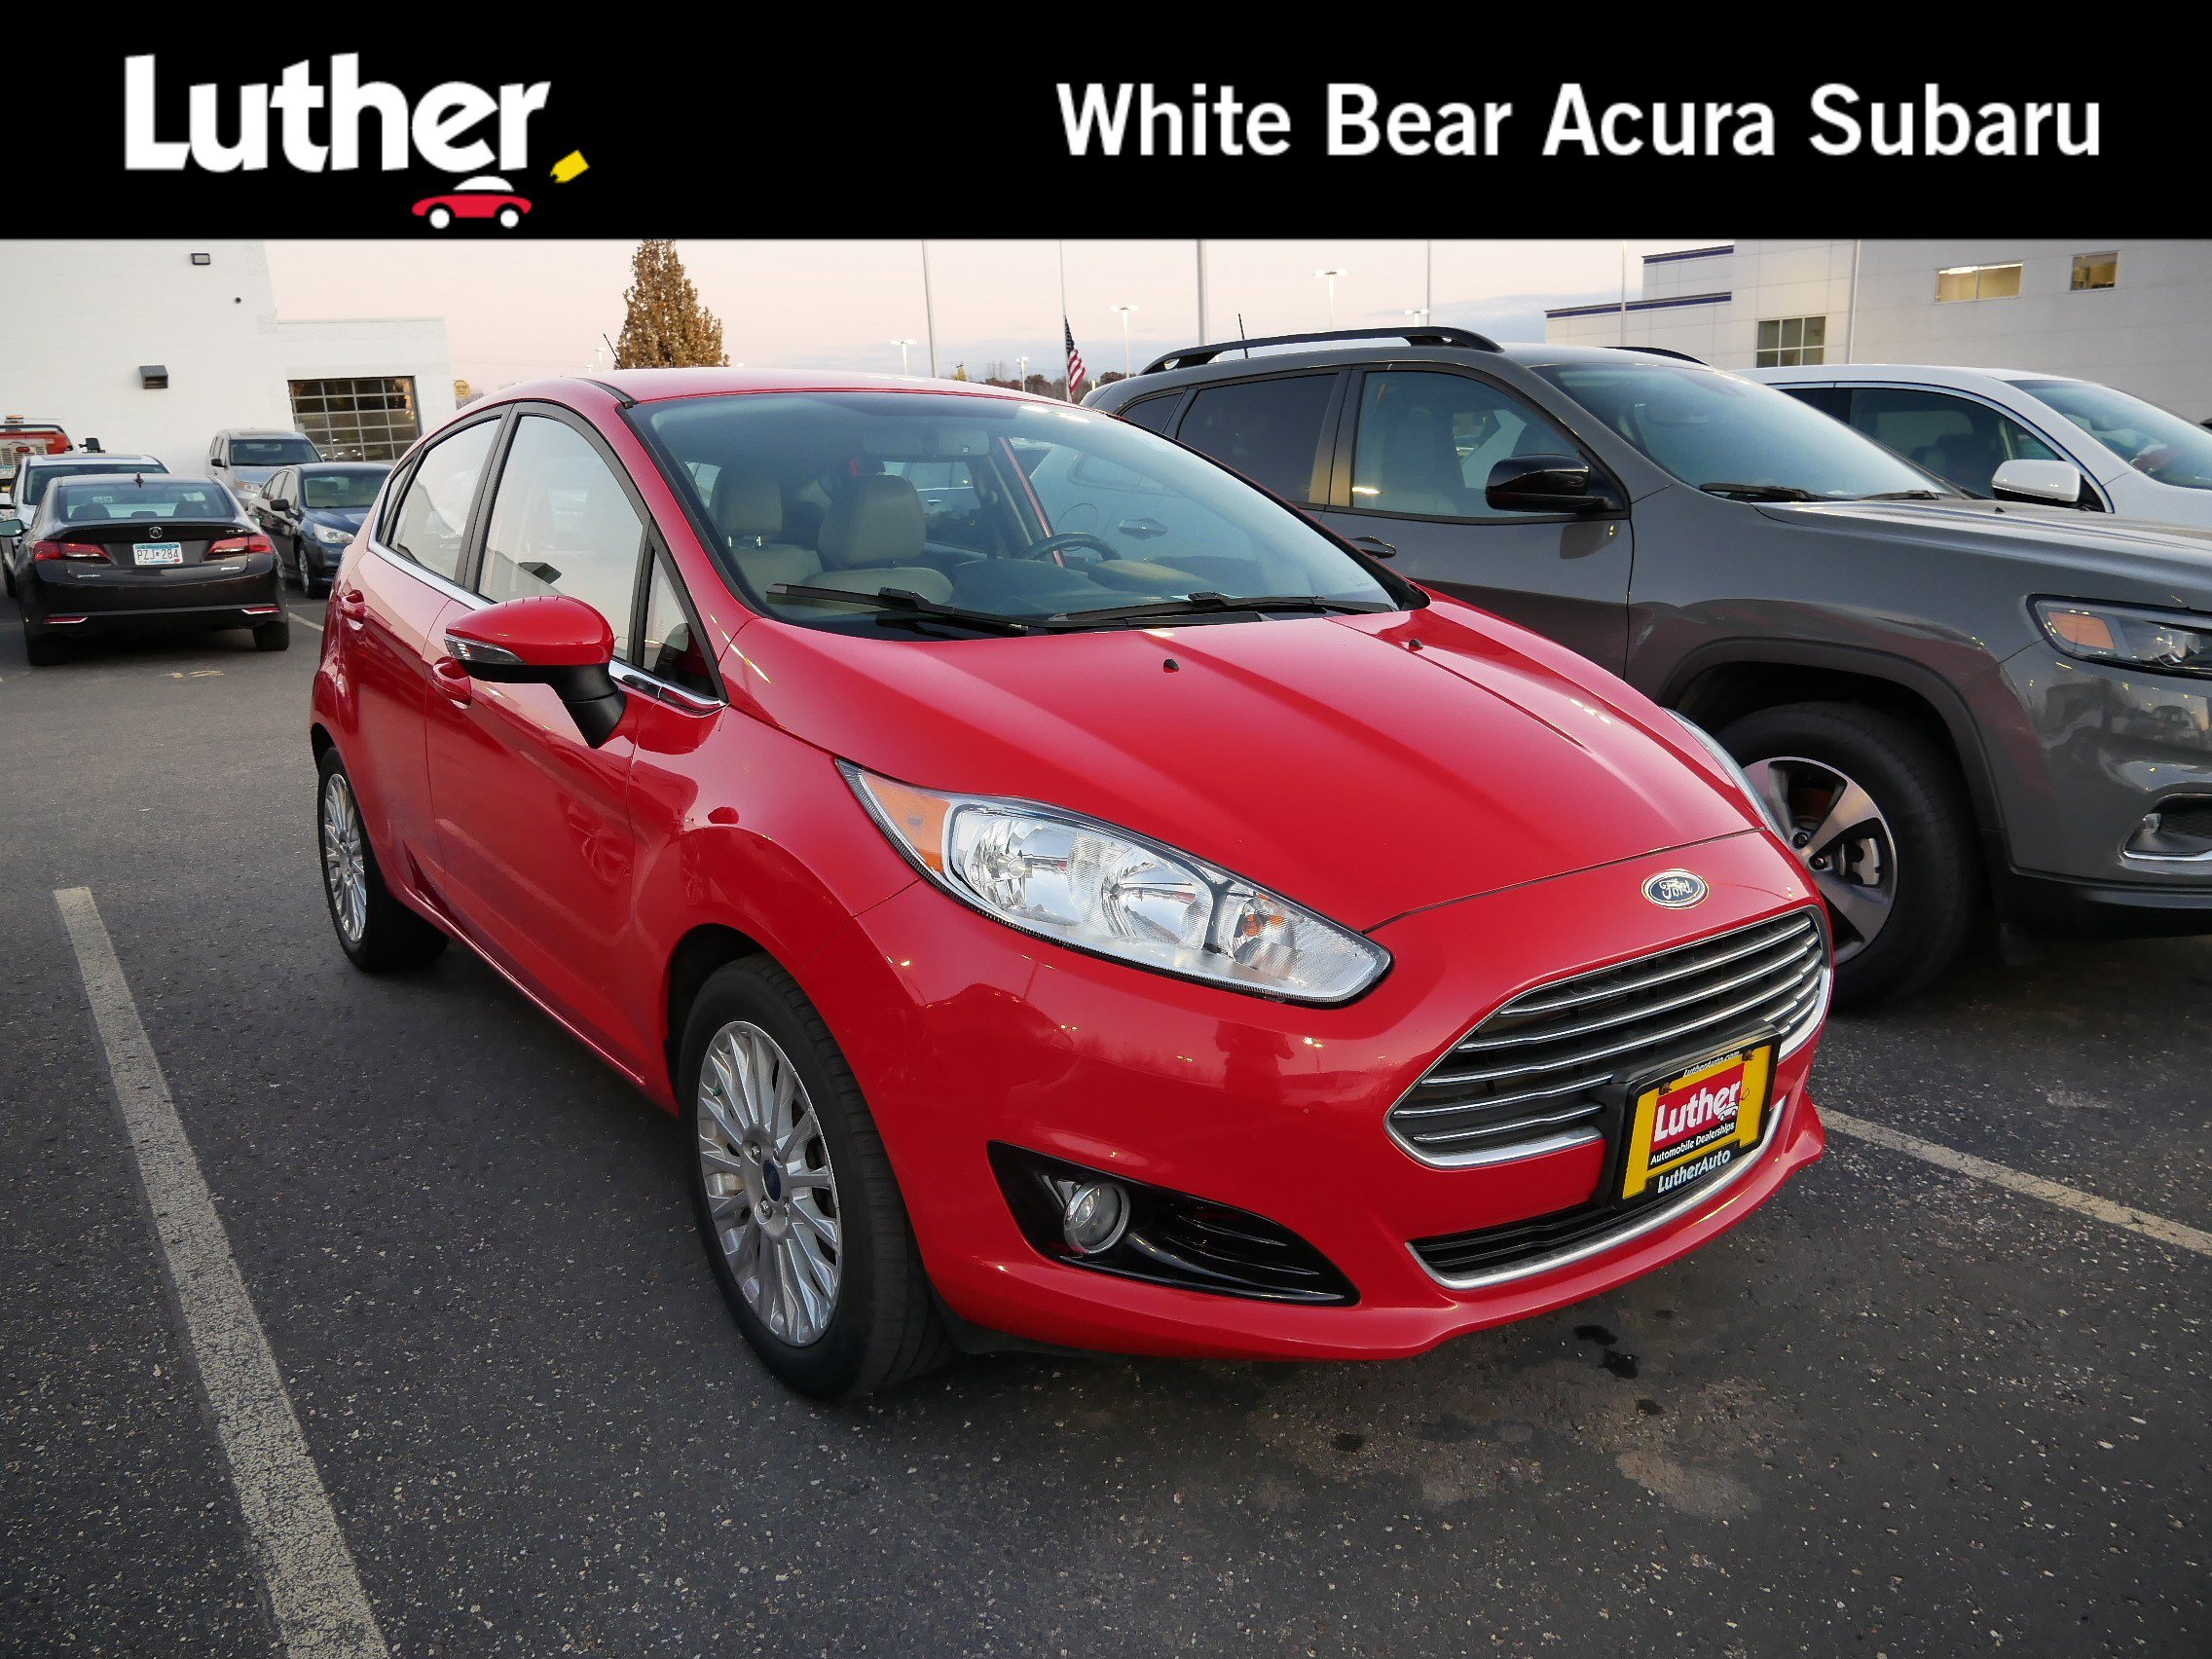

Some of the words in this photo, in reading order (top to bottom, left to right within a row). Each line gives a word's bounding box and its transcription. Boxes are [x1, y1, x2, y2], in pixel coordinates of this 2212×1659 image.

[1658, 878, 1693, 900] Ford
[1653, 1081, 1742, 1143] Luther
[1649, 1140, 1695, 1165] Automobile
[1695, 1122, 1735, 1146] Dealerships
[1657, 1150, 1731, 1194] LutherAuto
